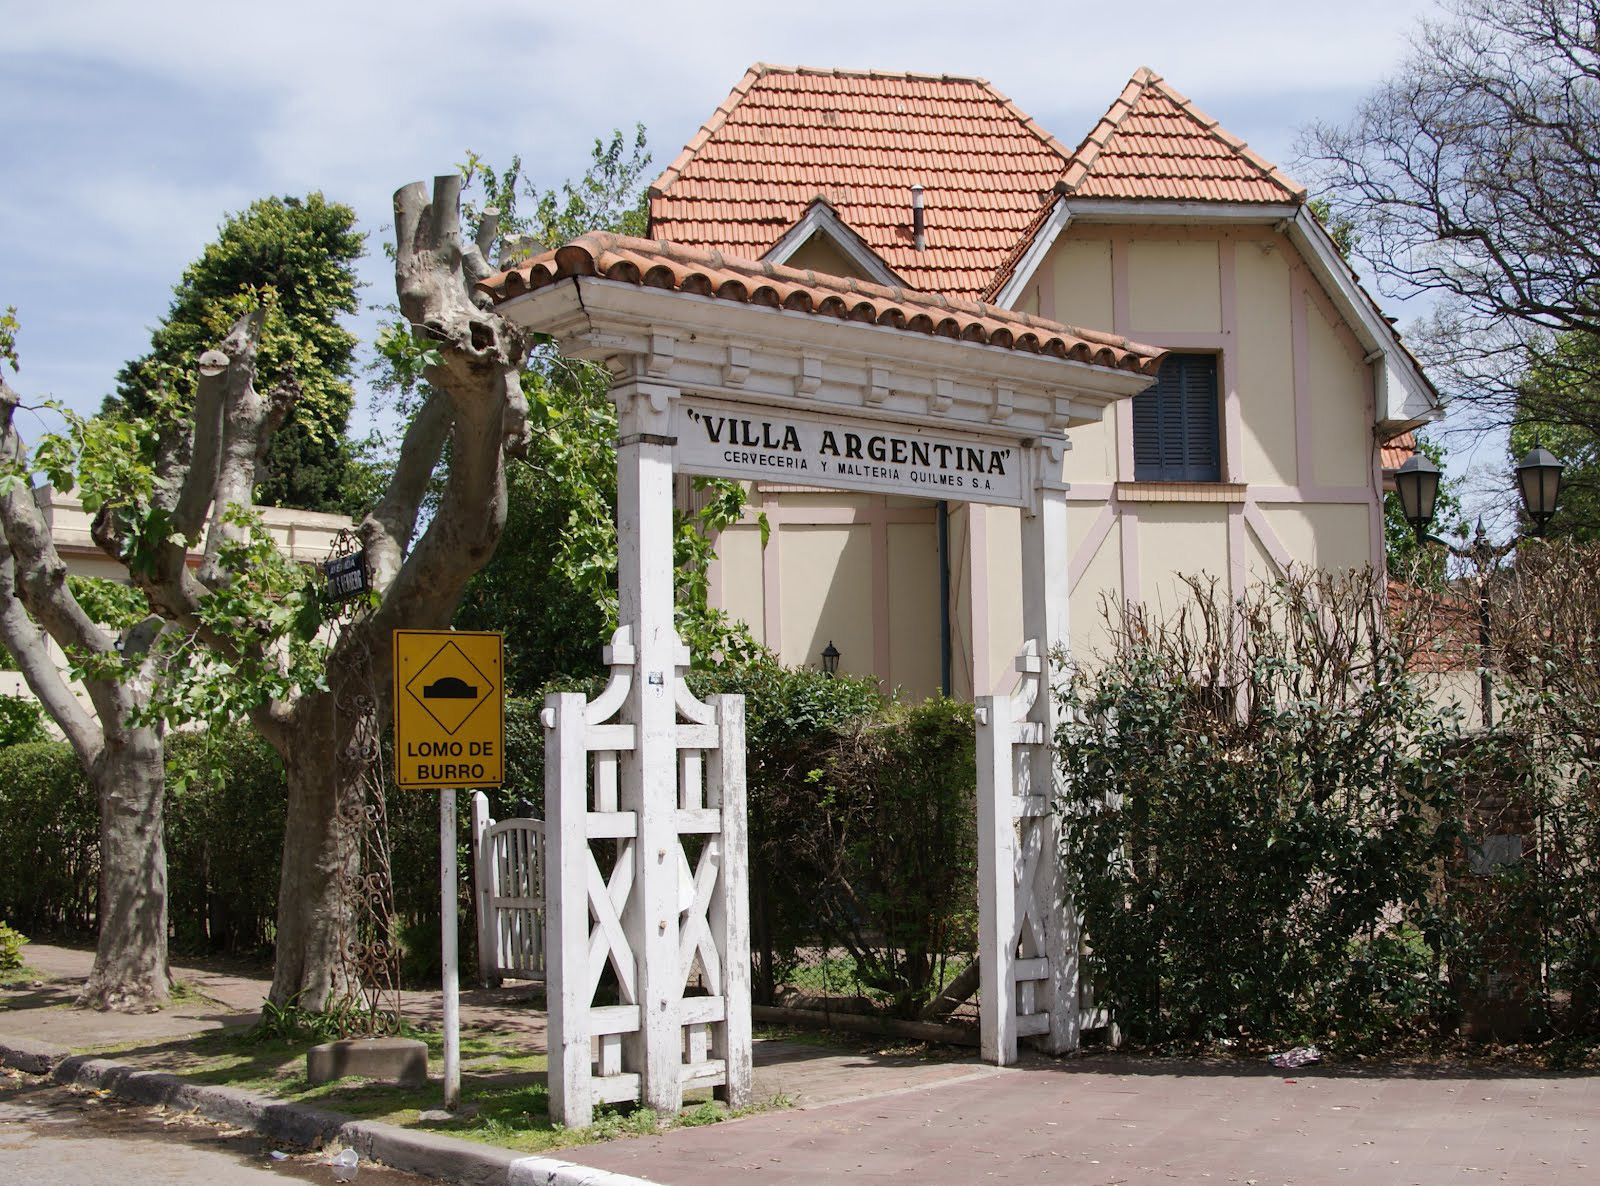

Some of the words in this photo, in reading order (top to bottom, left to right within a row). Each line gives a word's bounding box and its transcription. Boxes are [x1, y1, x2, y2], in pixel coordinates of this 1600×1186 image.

[724, 451, 808, 470] CERVECERIA
[821, 461, 828, 472] Y
[838, 463, 900, 480] MALTERIA
[910, 471, 963, 487] QUILMES
[972, 478, 995, 491] S.A.
[407, 742, 463, 757] LOMO
[469, 742, 494, 756] DE
[418, 764, 485, 779] BURRO
